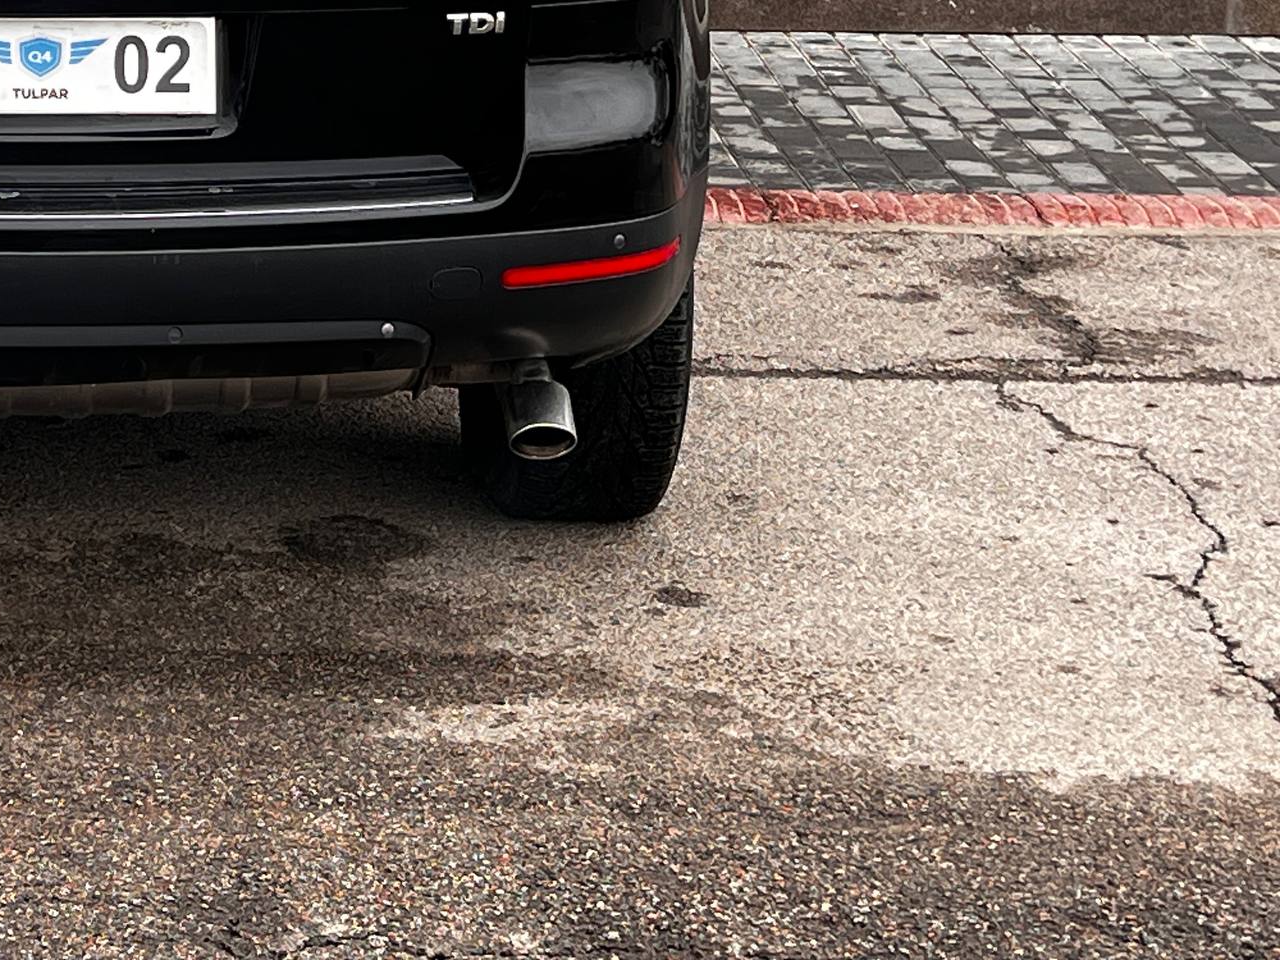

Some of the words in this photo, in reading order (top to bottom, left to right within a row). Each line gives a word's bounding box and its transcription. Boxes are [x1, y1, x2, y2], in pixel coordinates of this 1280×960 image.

[446, 11, 506, 35] TDI
[27, 50, 53, 65] Q4
[114, 35, 191, 94] 02
[13, 88, 69, 100] TULPAR
